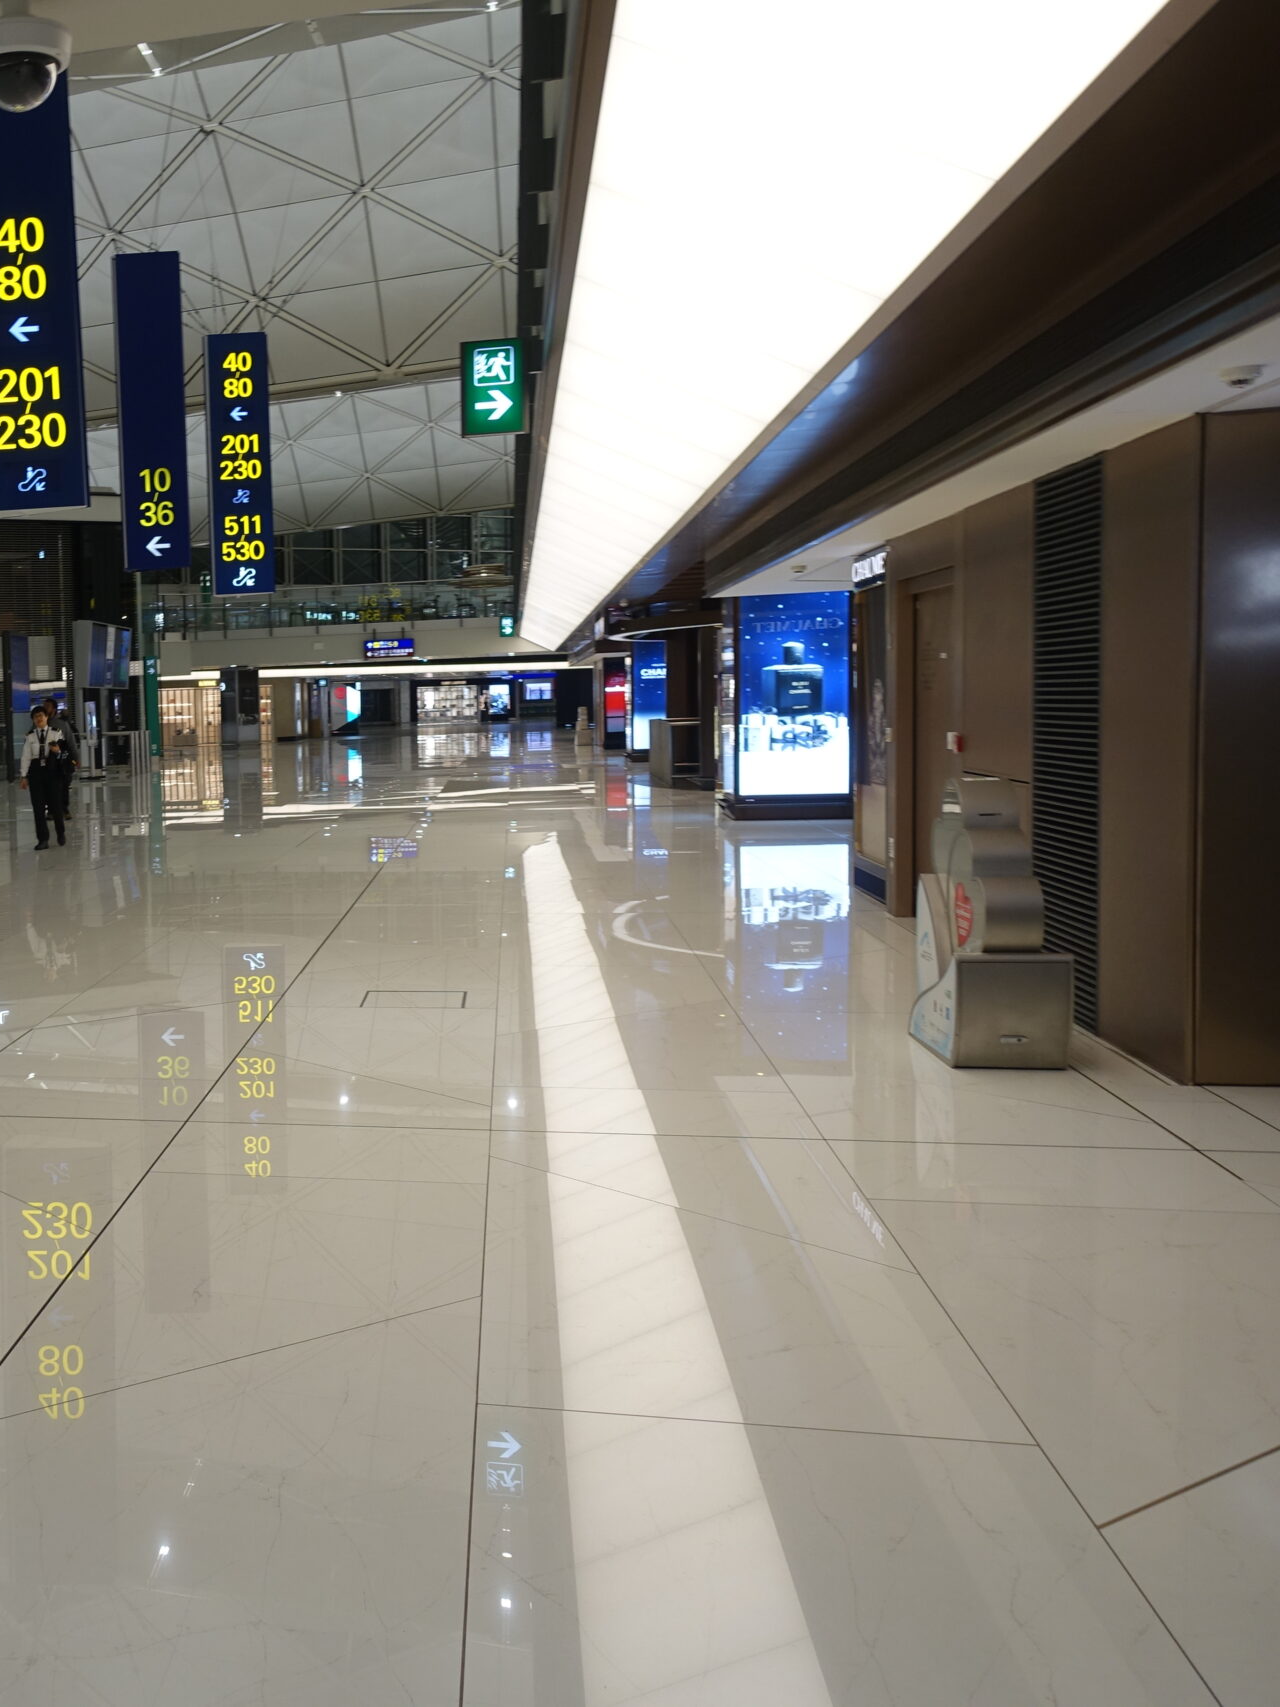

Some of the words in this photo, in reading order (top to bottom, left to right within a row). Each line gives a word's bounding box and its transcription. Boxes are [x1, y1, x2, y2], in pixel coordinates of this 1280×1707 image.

[222, 352, 253, 373] 40
[223, 377, 253, 398] 80
[220, 434, 259, 456] 201
[220, 458, 262, 480] 230
[139, 467, 172, 494] 10
[139, 501, 174, 527] 36
[223, 515, 261, 536] 511
[221, 539, 265, 562] 530
